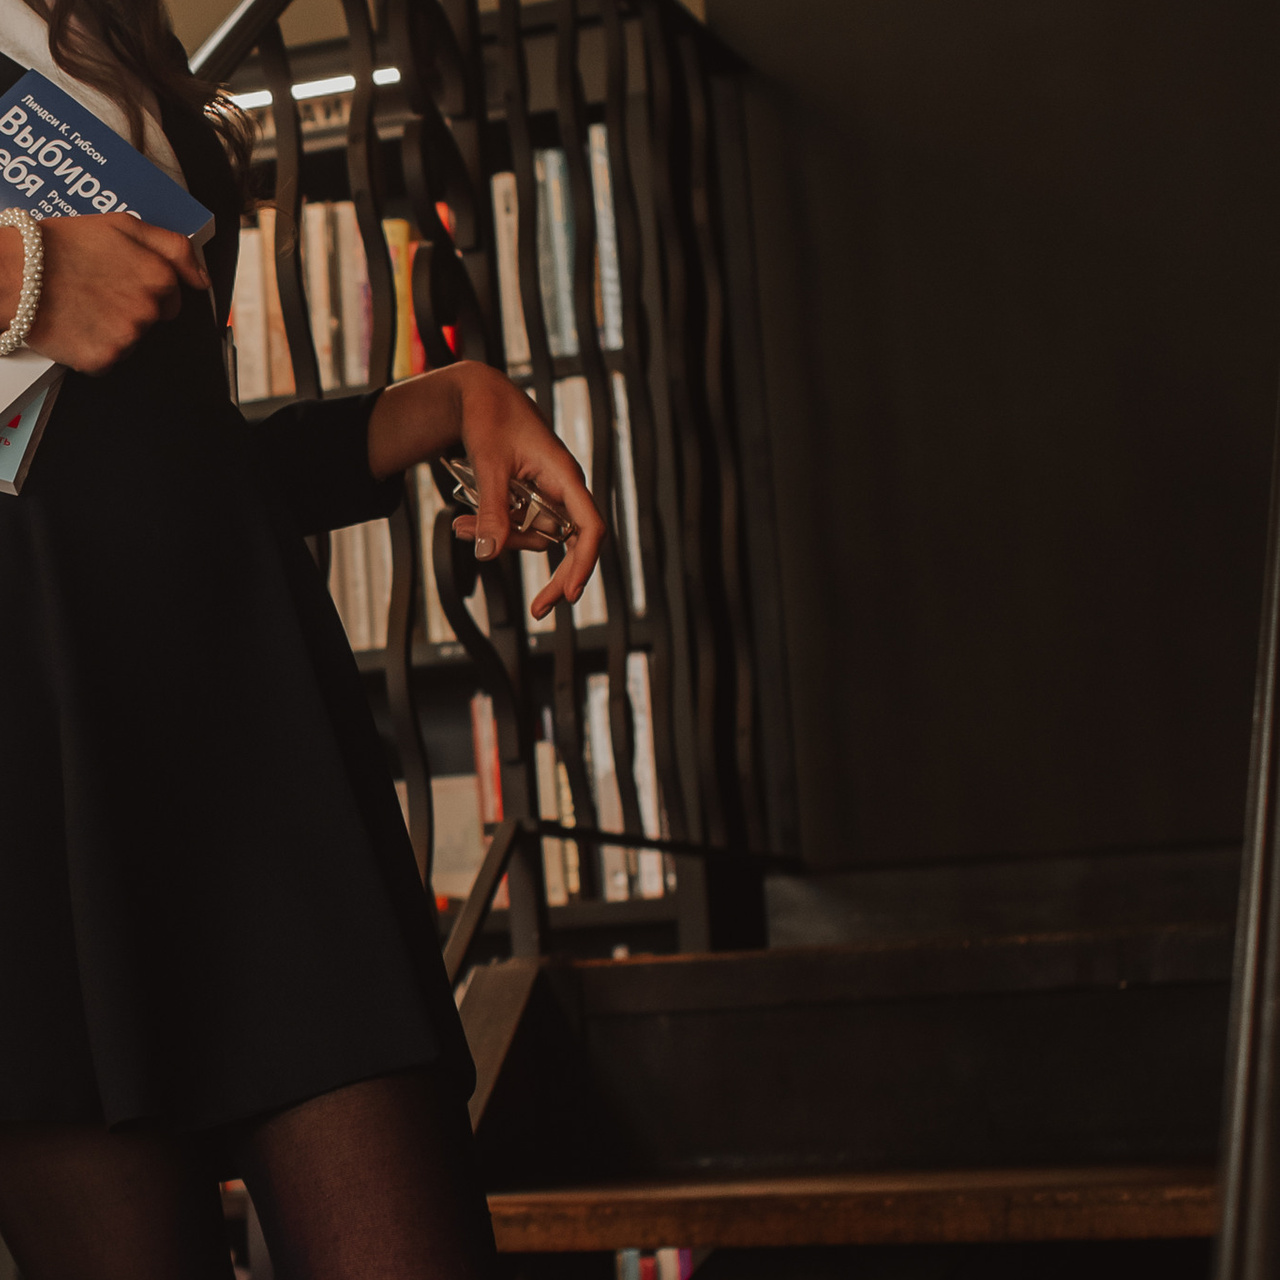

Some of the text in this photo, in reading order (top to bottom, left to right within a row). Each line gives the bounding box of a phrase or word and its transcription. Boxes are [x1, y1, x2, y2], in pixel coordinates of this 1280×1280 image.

[21, 94, 108, 166] Линдси К. Гибсон
[38, 200, 53, 213] по
[47, 189, 81, 218] Руков
